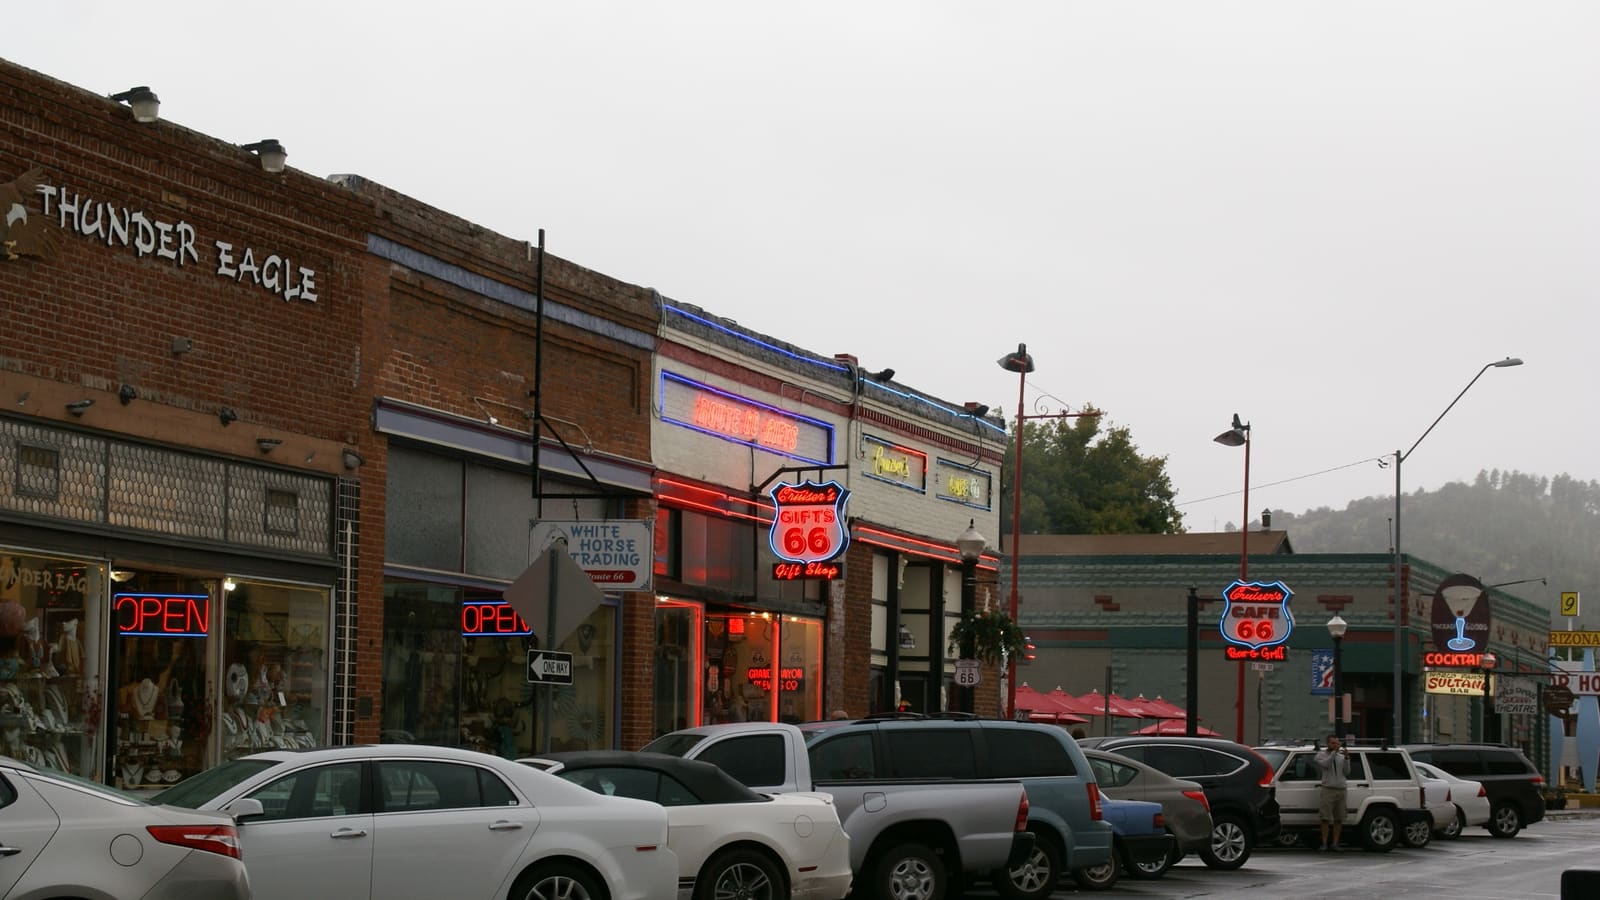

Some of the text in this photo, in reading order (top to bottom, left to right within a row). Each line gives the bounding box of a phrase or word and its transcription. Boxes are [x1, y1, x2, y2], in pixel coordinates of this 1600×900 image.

[36, 184, 318, 302] THUNDER EAGLE
[778, 487, 836, 502] Cruiser's
[780, 509, 835, 523] GIFTS
[570, 526, 619, 538] WHITE
[580, 539, 635, 552] HORSE
[784, 527, 830, 555] 66
[570, 553, 640, 566] TRADING
[613, 572, 624, 580] 66
[775, 563, 838, 580] Gift Shop
[1229, 586, 1284, 601] Cruiser's
[1564, 597, 1575, 611] 9
[116, 597, 208, 633] OPEN
[462, 604, 530, 632] OPEN
[1231, 606, 1280, 618] CAFE
[1236, 620, 1273, 640] 66
[1227, 646, 1247, 659] Bar
[1260, 646, 1285, 660] Grill
[543, 661, 568, 674] ONE WAY
[961, 673, 974, 683] 66
[1496, 704, 1536, 714] THEATRE
